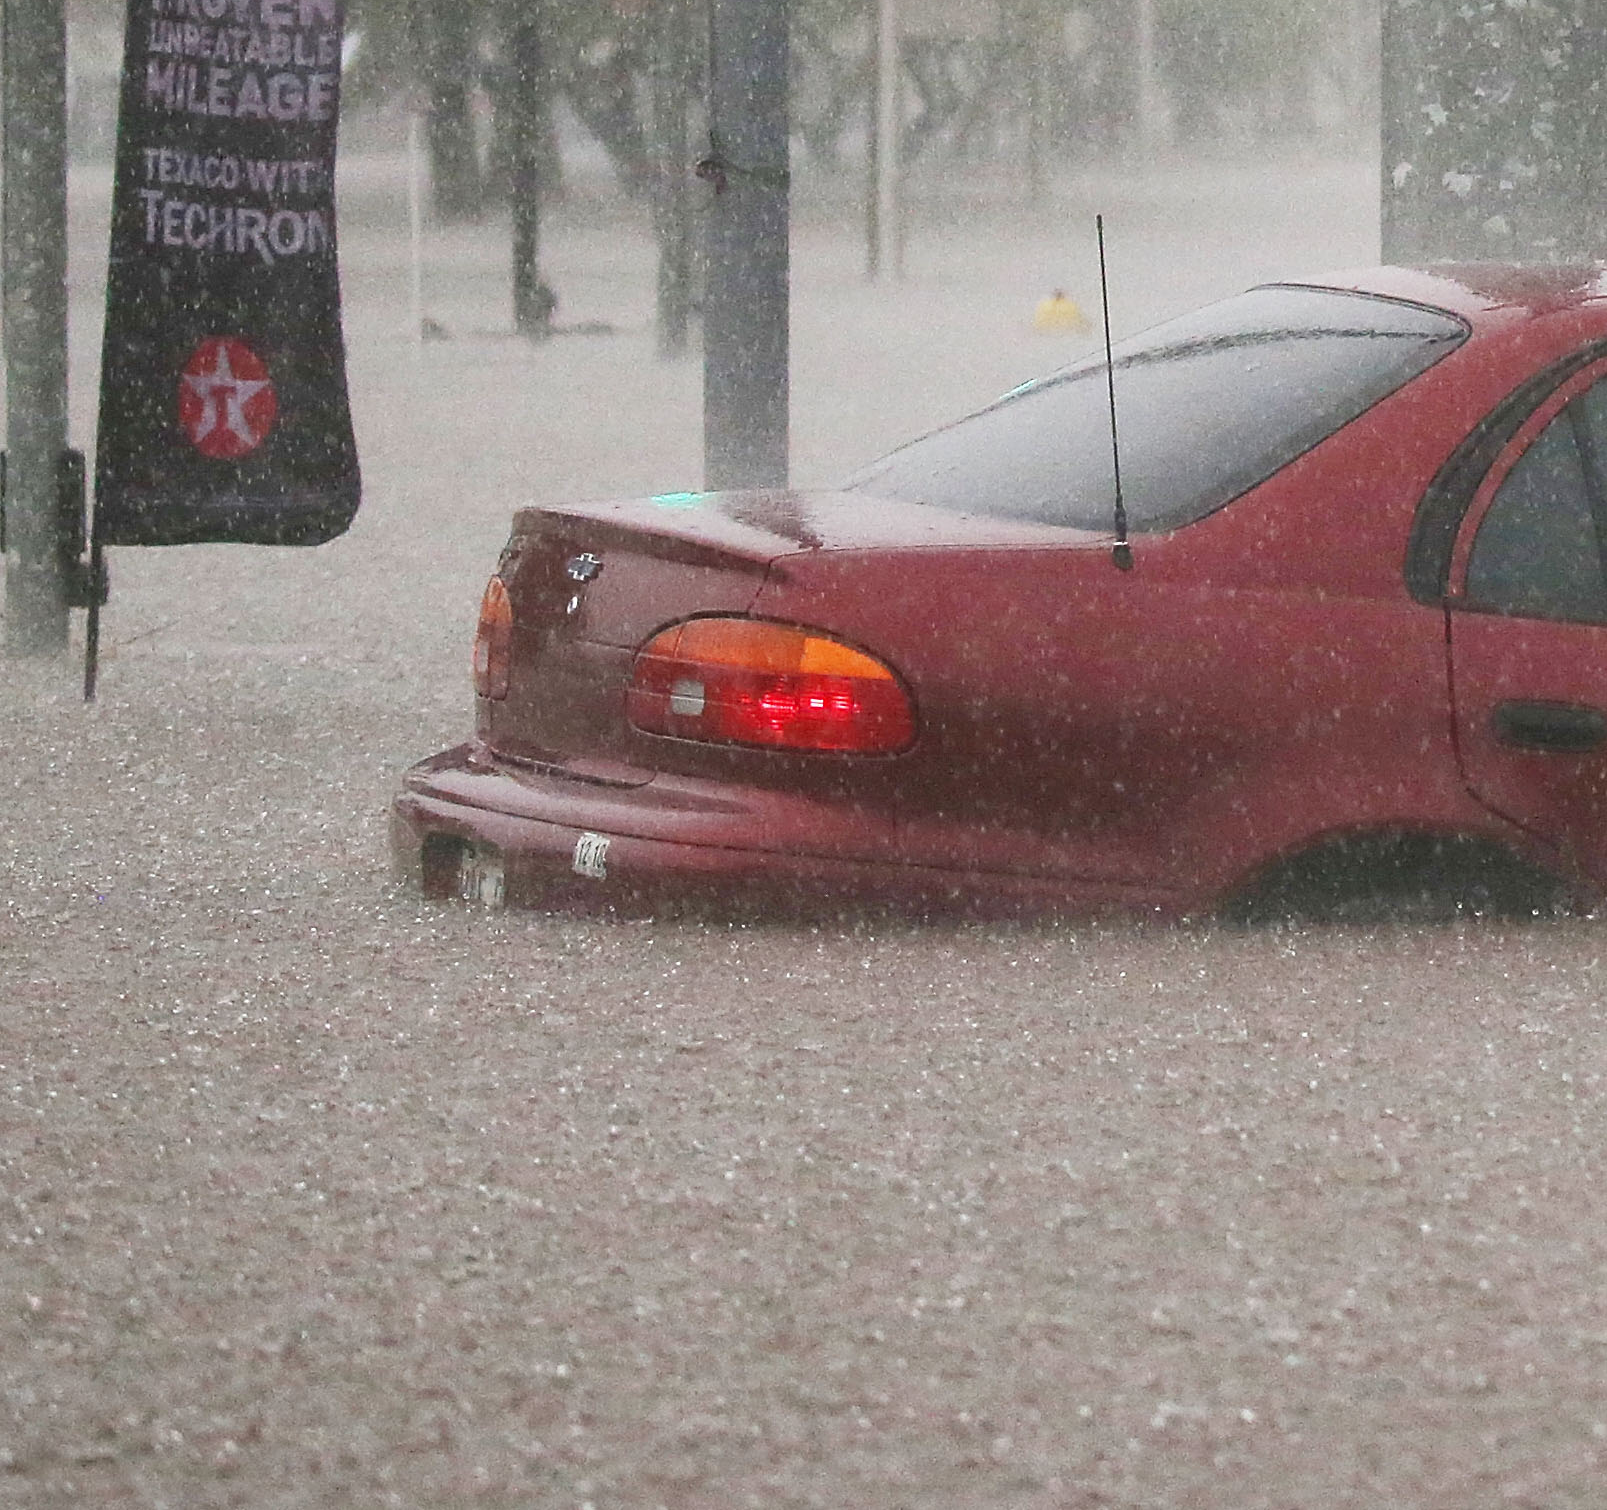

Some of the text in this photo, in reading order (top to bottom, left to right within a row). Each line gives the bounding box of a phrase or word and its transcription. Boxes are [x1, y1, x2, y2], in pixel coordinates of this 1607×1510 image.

[149, 19, 336, 67] UNBEATABLE
[146, 58, 336, 121] MILEAGE
[142, 146, 240, 190] TEXACO
[140, 188, 331, 267] TECHRON
